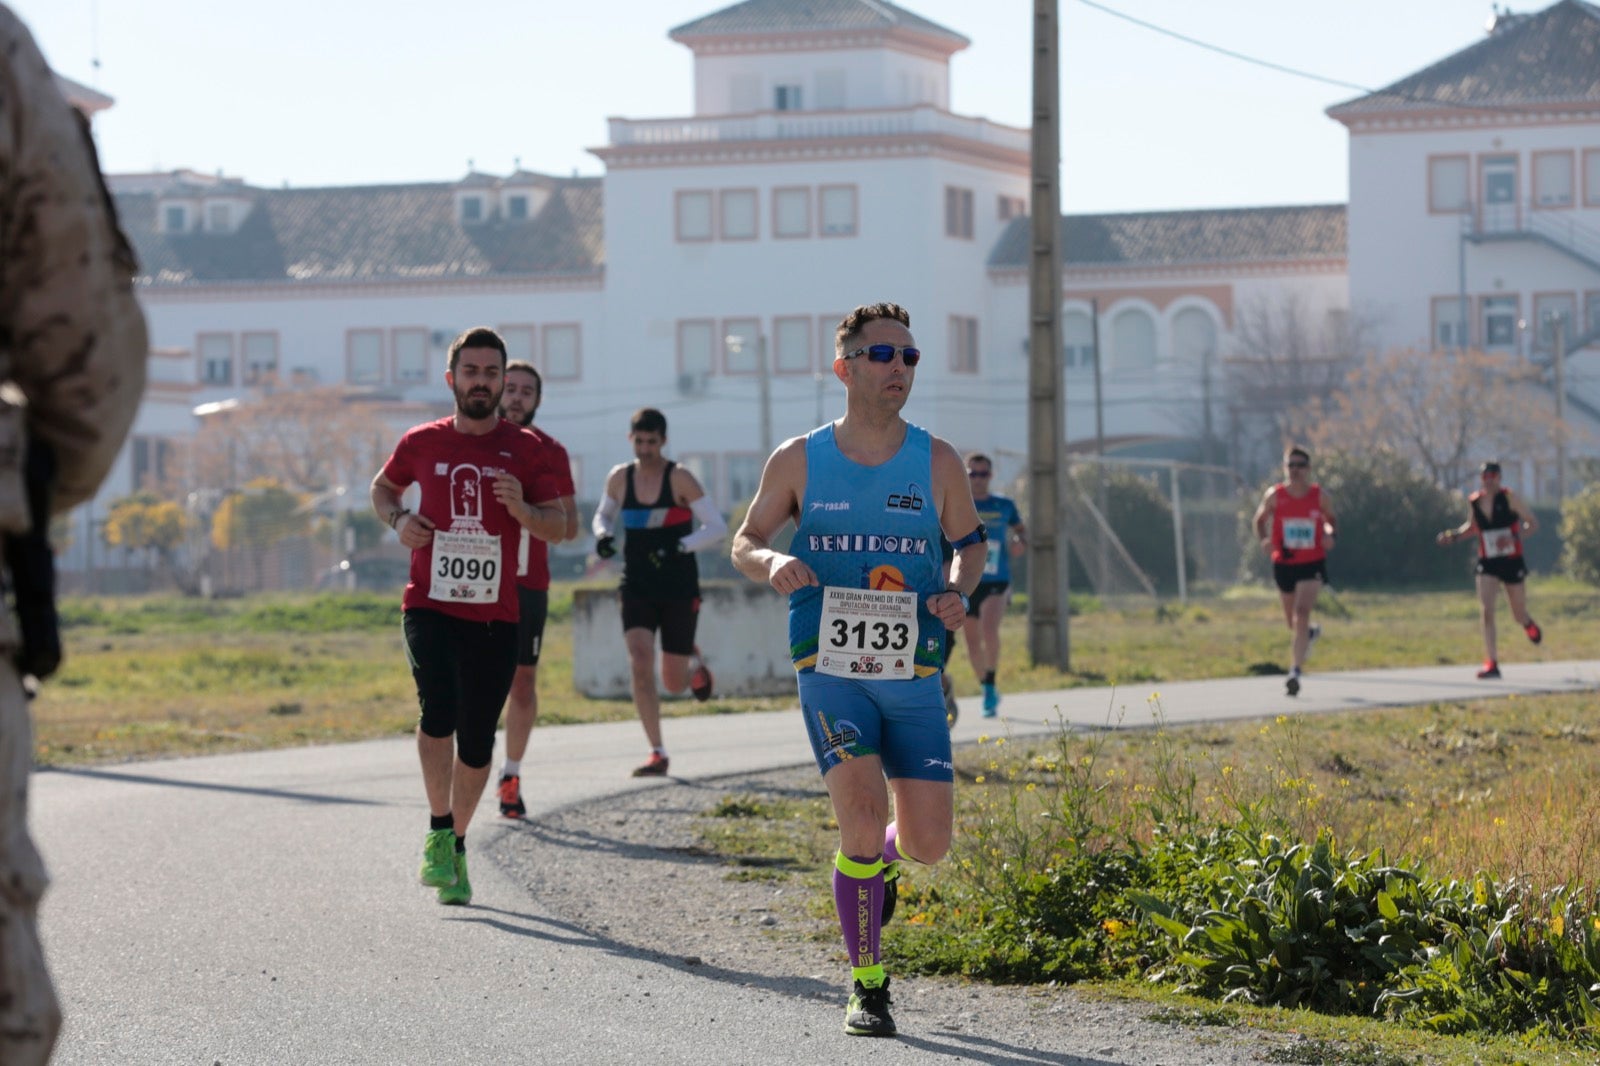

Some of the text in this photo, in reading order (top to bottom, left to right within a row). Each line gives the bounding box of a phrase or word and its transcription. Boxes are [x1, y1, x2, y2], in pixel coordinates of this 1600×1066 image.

[887, 493, 923, 511] cab
[809, 534, 928, 554] BENIDORM
[438, 556, 496, 581] 3090
[845, 592, 862, 601] GRAN
[863, 594, 886, 603] PREMIO
[886, 595, 894, 604] DE
[895, 596, 912, 605] FONDO
[830, 618, 909, 650] 3133
[858, 886, 869, 954] COMPRESPORT
